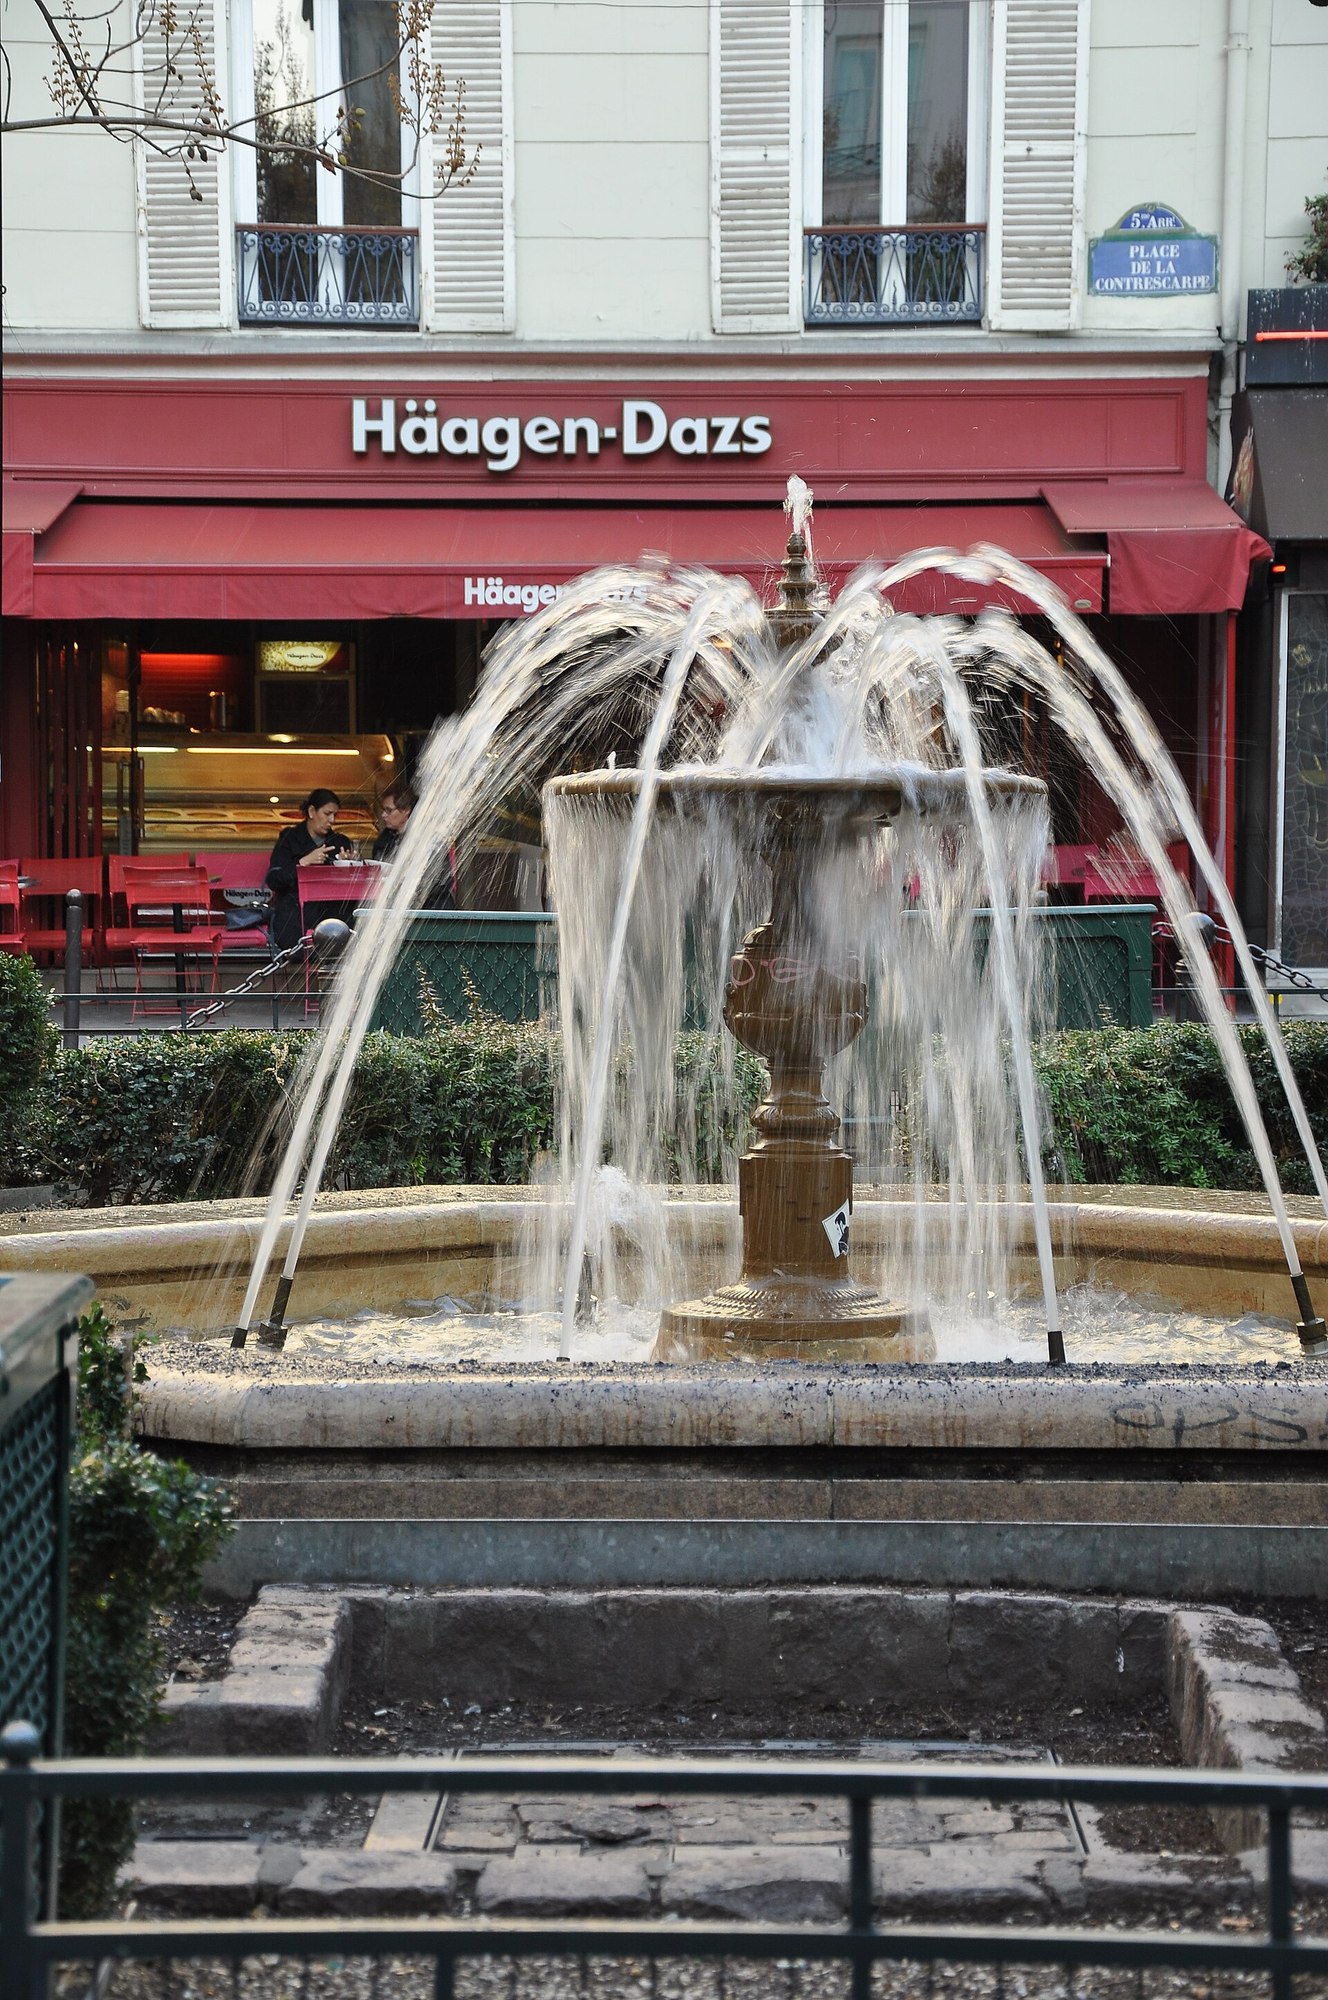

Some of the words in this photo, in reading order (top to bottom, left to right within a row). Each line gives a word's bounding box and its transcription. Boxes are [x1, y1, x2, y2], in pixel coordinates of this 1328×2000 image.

[1129, 245, 1180, 258] PLACE
[1131, 261, 1151, 274] DE
[1156, 261, 1176, 274] LA
[1095, 275, 1210, 291] CONTRESCARPE
[352, 397, 773, 472] Häagen-Dazs
